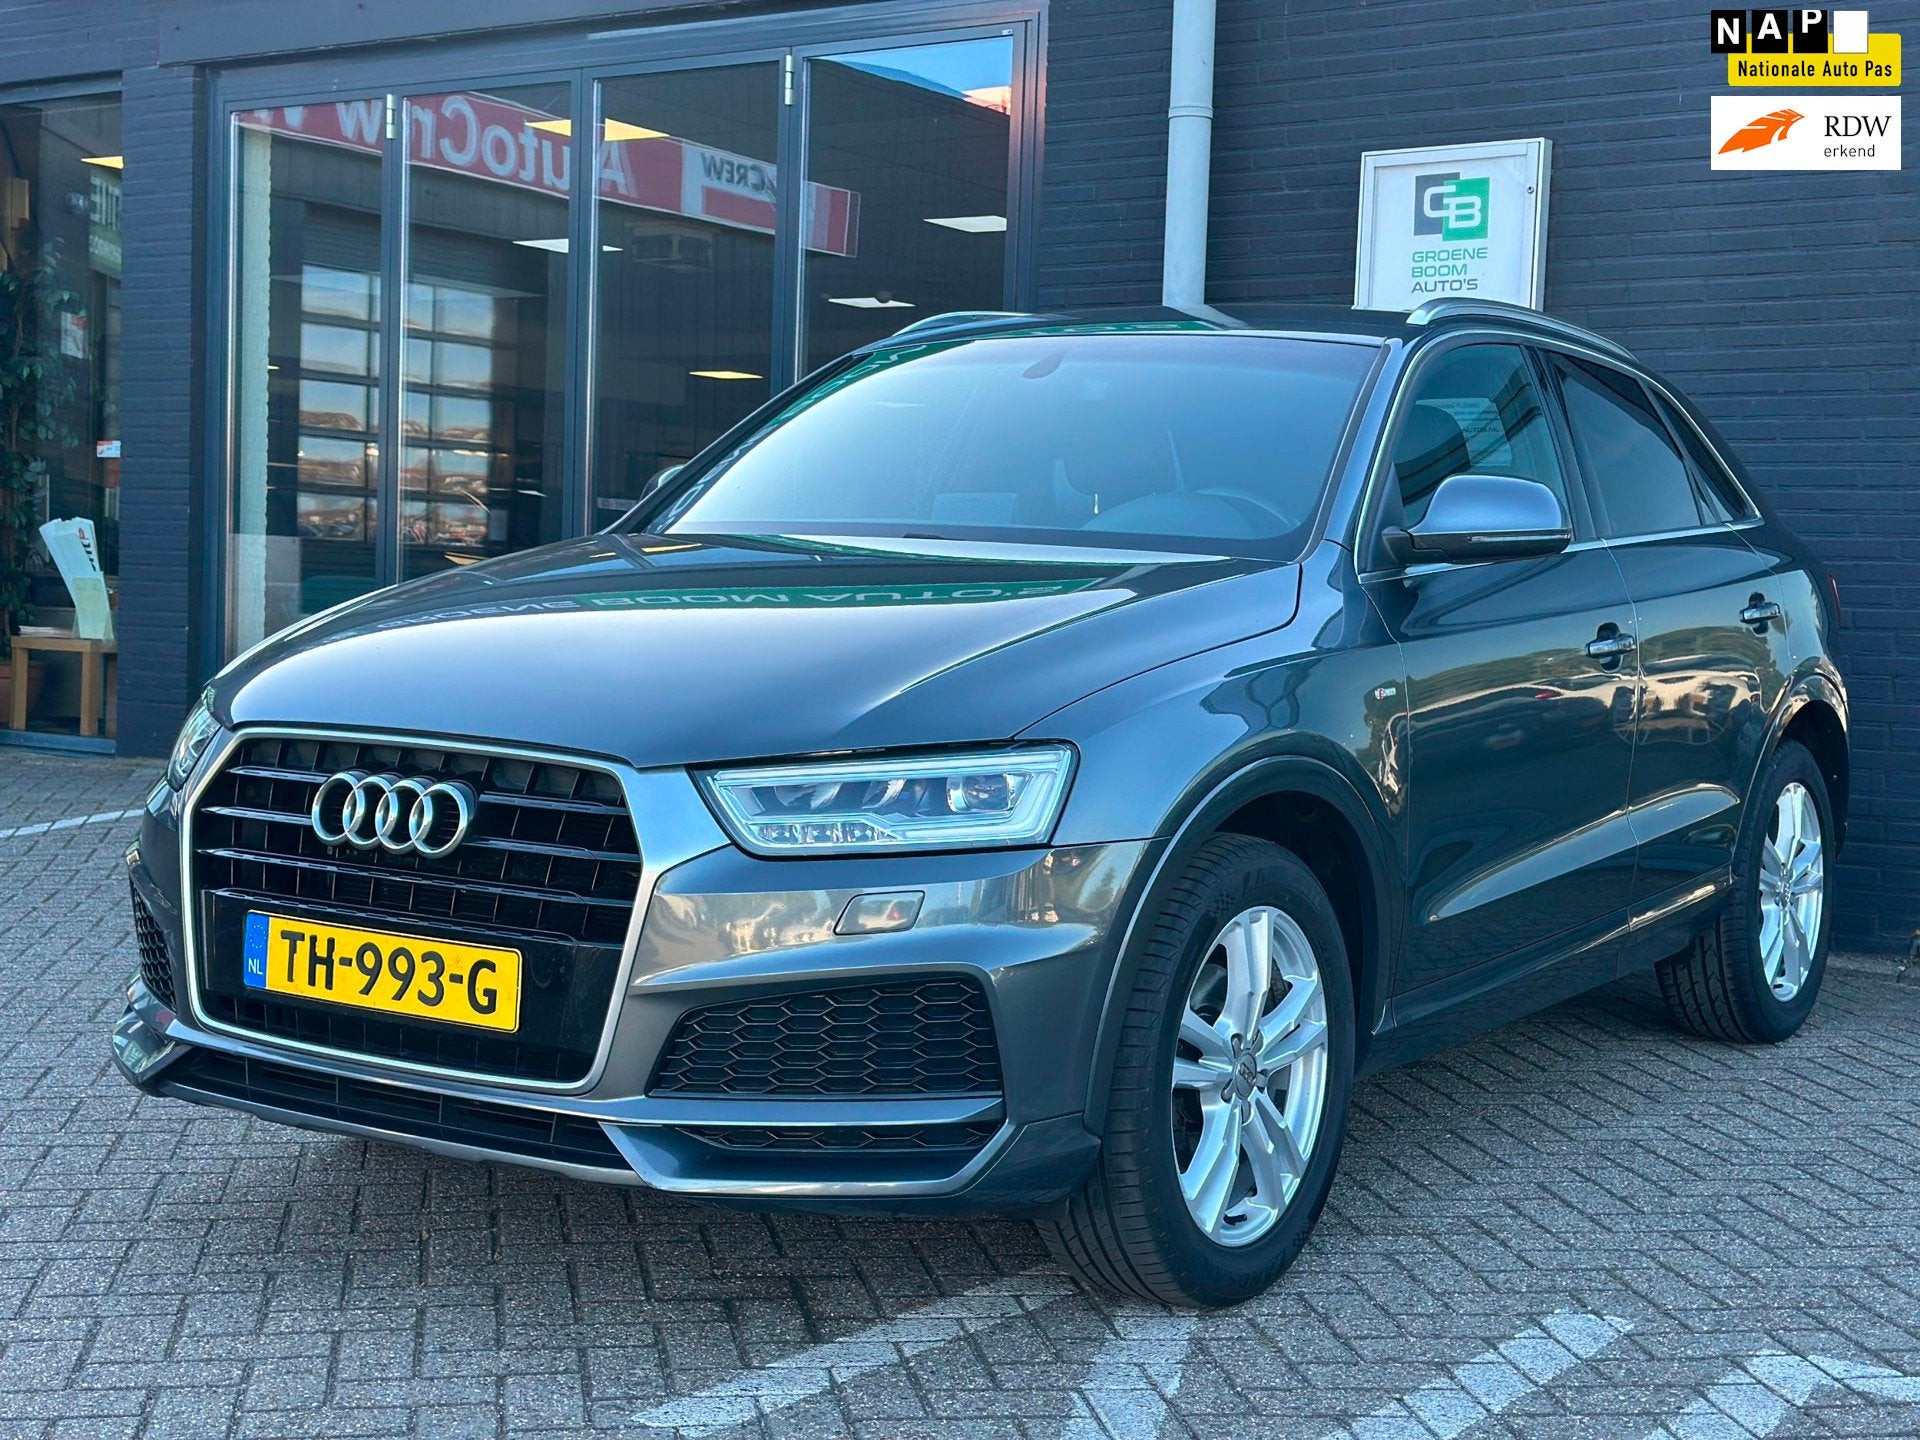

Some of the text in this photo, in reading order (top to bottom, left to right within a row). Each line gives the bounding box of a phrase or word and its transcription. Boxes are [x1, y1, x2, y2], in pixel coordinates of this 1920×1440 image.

[1412, 247, 1489, 263] GROENE
[1411, 263, 1468, 278] BOOM
[1411, 278, 1479, 293] AUTO'S
[248, 958, 264, 976] NL
[280, 929, 498, 1015] TH-993-G
